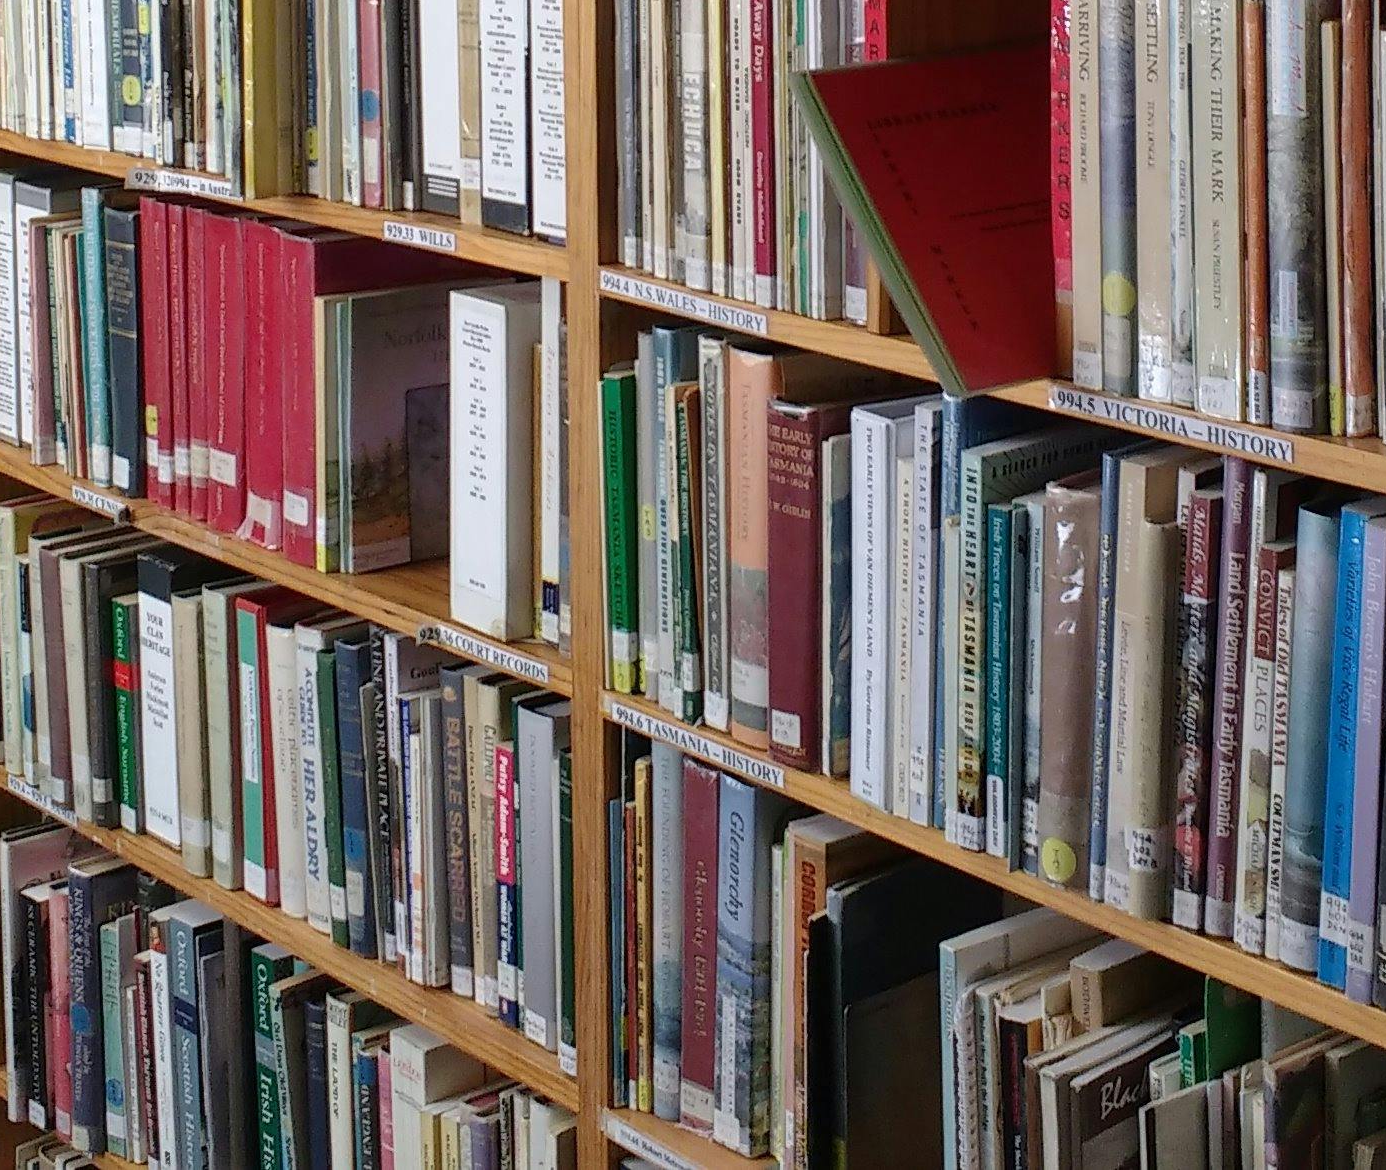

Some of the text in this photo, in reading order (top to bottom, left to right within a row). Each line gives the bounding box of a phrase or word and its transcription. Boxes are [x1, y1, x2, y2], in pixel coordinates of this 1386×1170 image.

[752, 45, 766, 82] Days
[753, 3, 766, 42] Away
[1144, 3, 1160, 83] SETTLING
[682, 71, 703, 172] ECHUCA
[1208, 89, 1225, 203] THEIR MARK
[386, 223, 452, 247] 929.33 WILLS
[603, 272, 763, 331] 994.4 N.S.WALES HISTORY
[783, 426, 813, 444] EARLY
[1056, 389, 1290, 462] 994.5 VICTORIA HISTORY
[866, 426, 875, 658] TWO EARLY VIEWS OF VAN DIEMEN'S LAND
[916, 423, 928, 638] THE STATE OF TASMANIA
[1230, 479, 1246, 524] Morgan
[146, 612, 164, 628] YOUR
[964, 467, 978, 693] INTO HEART TASMANIA
[989, 517, 1004, 704] Irish Traces on Tasmanian History
[1182, 505, 1208, 684] Maids, and
[115, 606, 127, 660] Oxford
[141, 636, 171, 658] HERITAGE
[146, 626, 164, 641] CLAN
[455, 634, 547, 683] COURT RECORDS
[1252, 568, 1276, 732] CONVICT PLACES
[1214, 551, 1246, 838] Land Settlement in Early Tasmania
[1271, 586, 1293, 768] Tales of Old TASMANIA
[445, 717, 462, 804] BATTLE
[615, 706, 781, 786] 994.6 TASMANIA HISTORY
[303, 758, 321, 880] HERALDRY
[497, 754, 511, 876] Patsy Adam-Smith
[72, 886, 84, 932] KINGS
[725, 811, 745, 922] Glenorchy
[175, 930, 195, 1104] Oxford Scottish
[256, 963, 274, 1124] Oxford Irish
